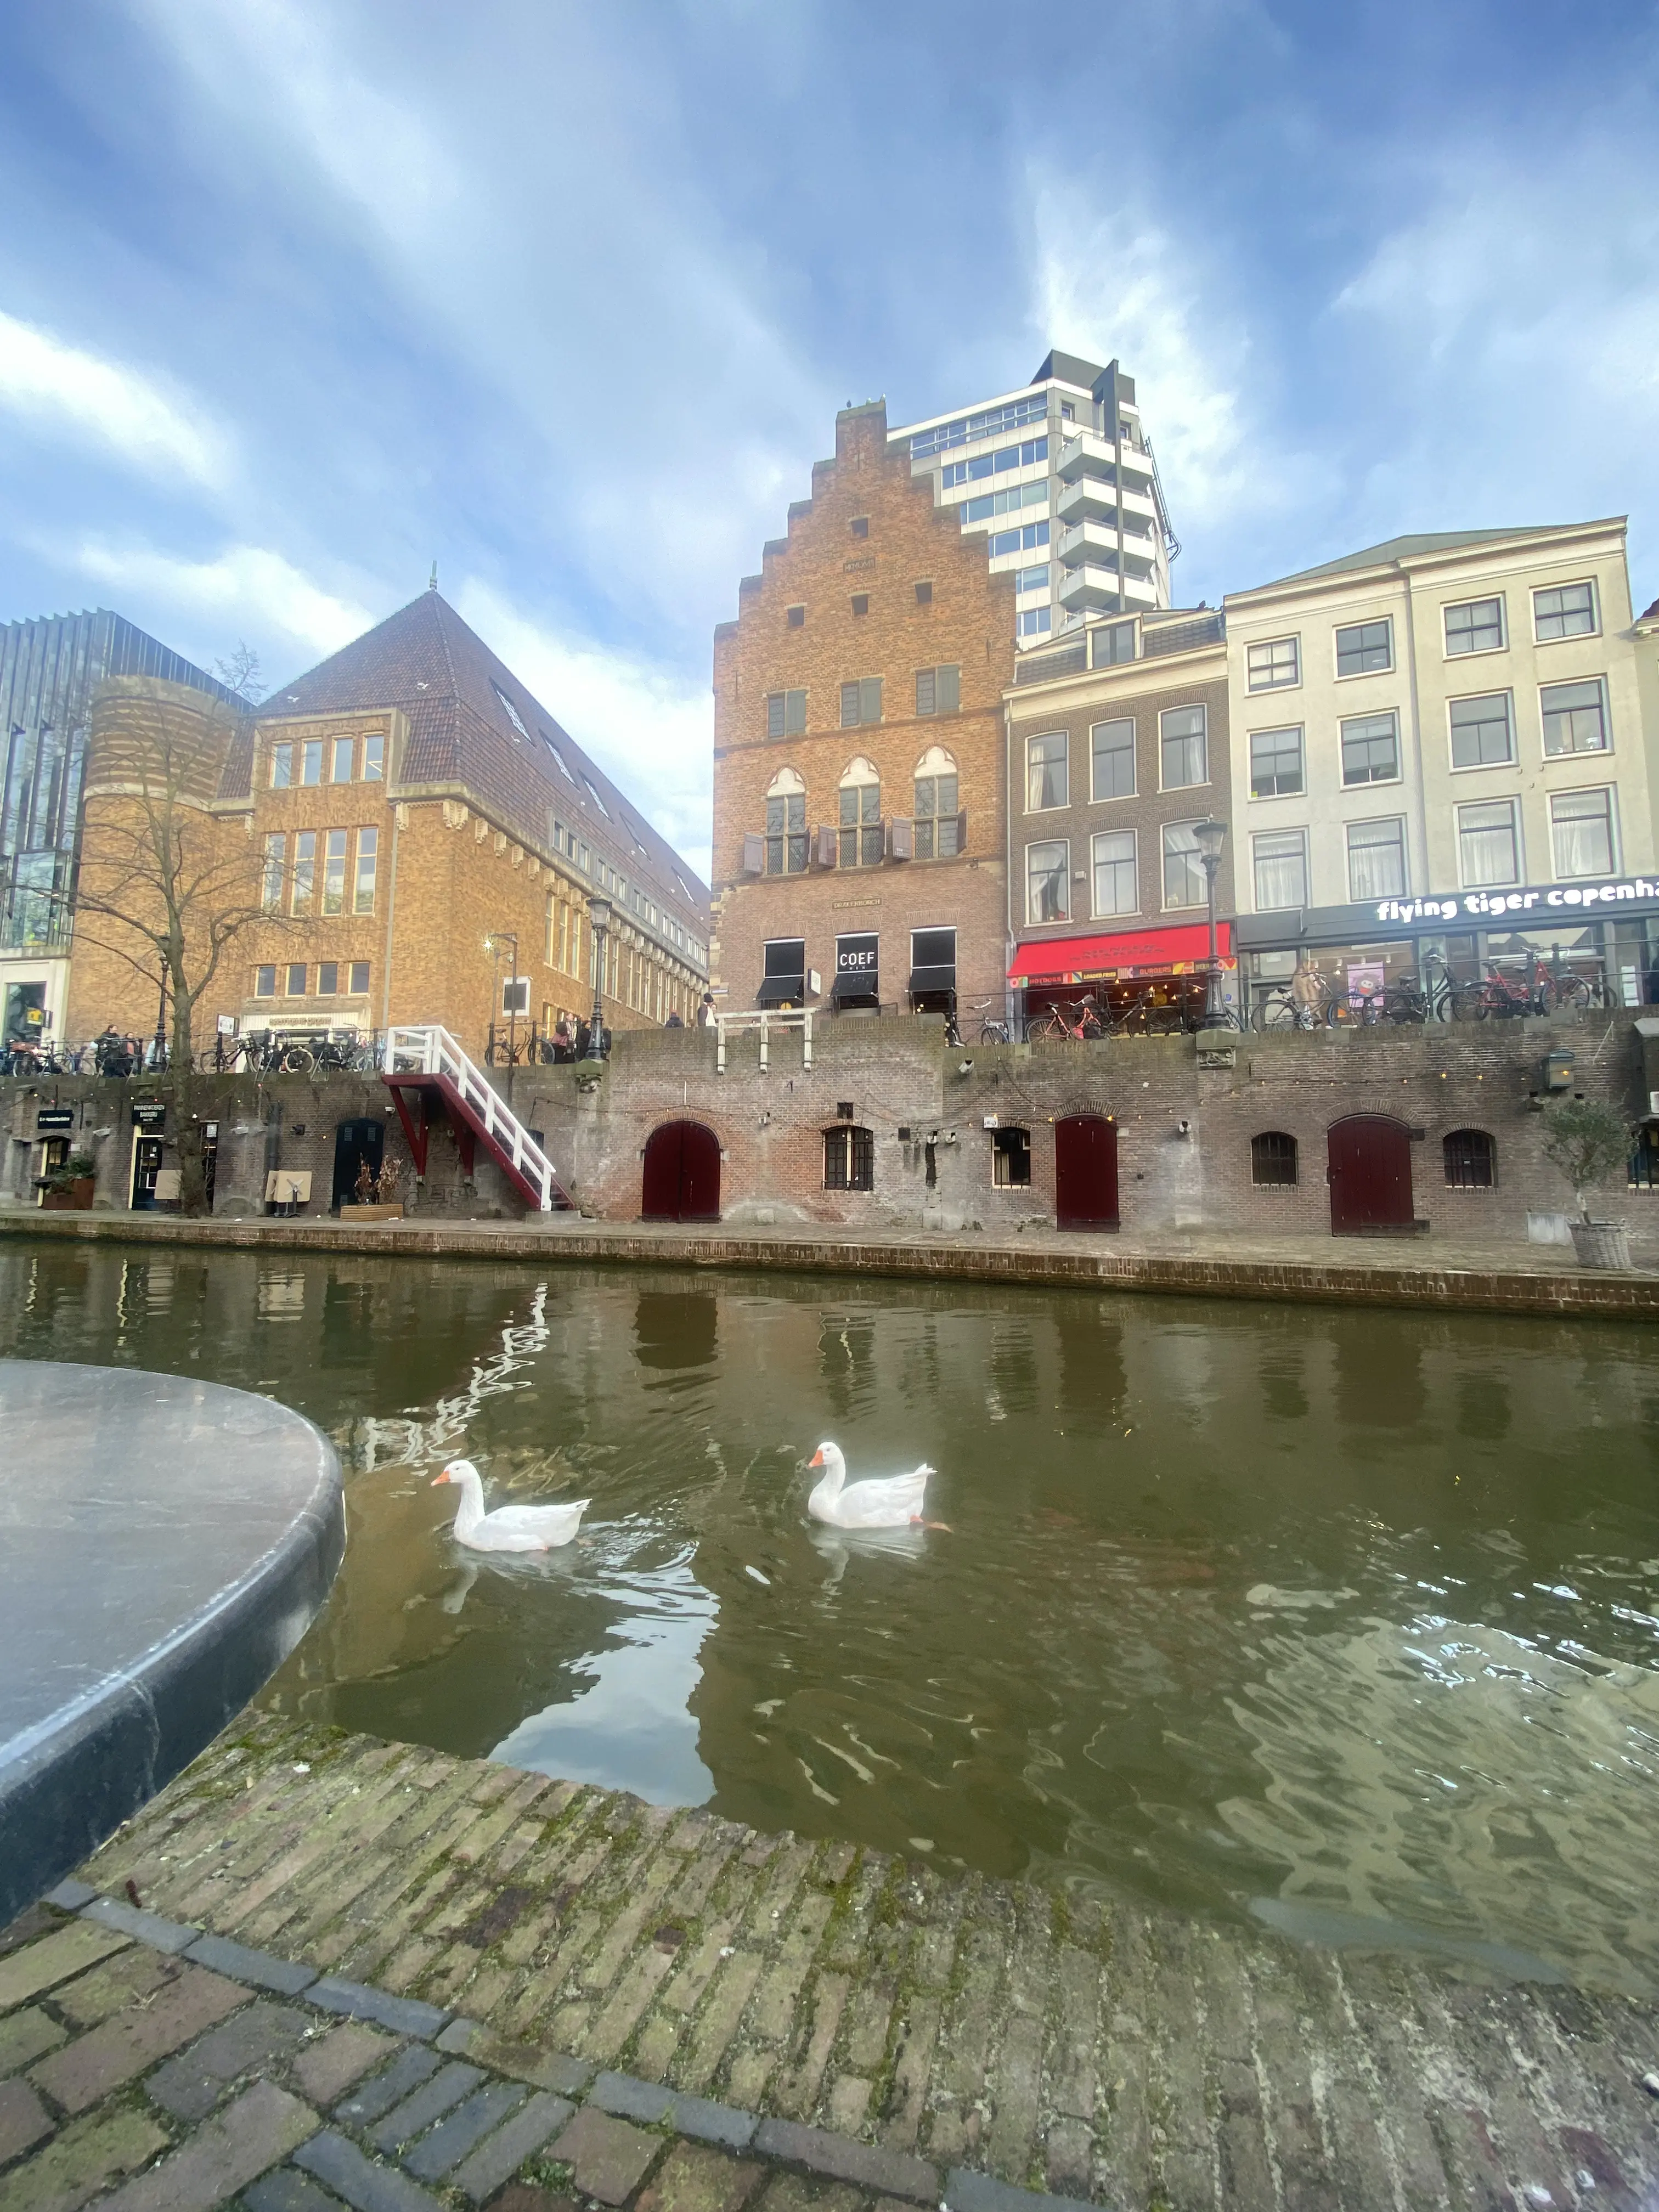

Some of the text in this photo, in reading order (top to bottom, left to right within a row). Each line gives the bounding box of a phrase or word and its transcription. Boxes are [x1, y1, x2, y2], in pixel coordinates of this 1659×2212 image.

[834, 899, 881, 909] DRAKENBORCH
[1377, 898, 1457, 923] flying
[1464, 893, 1539, 916] tiger
[840, 952, 875, 966] COEF
[1139, 967, 1171, 975] BURGERS
